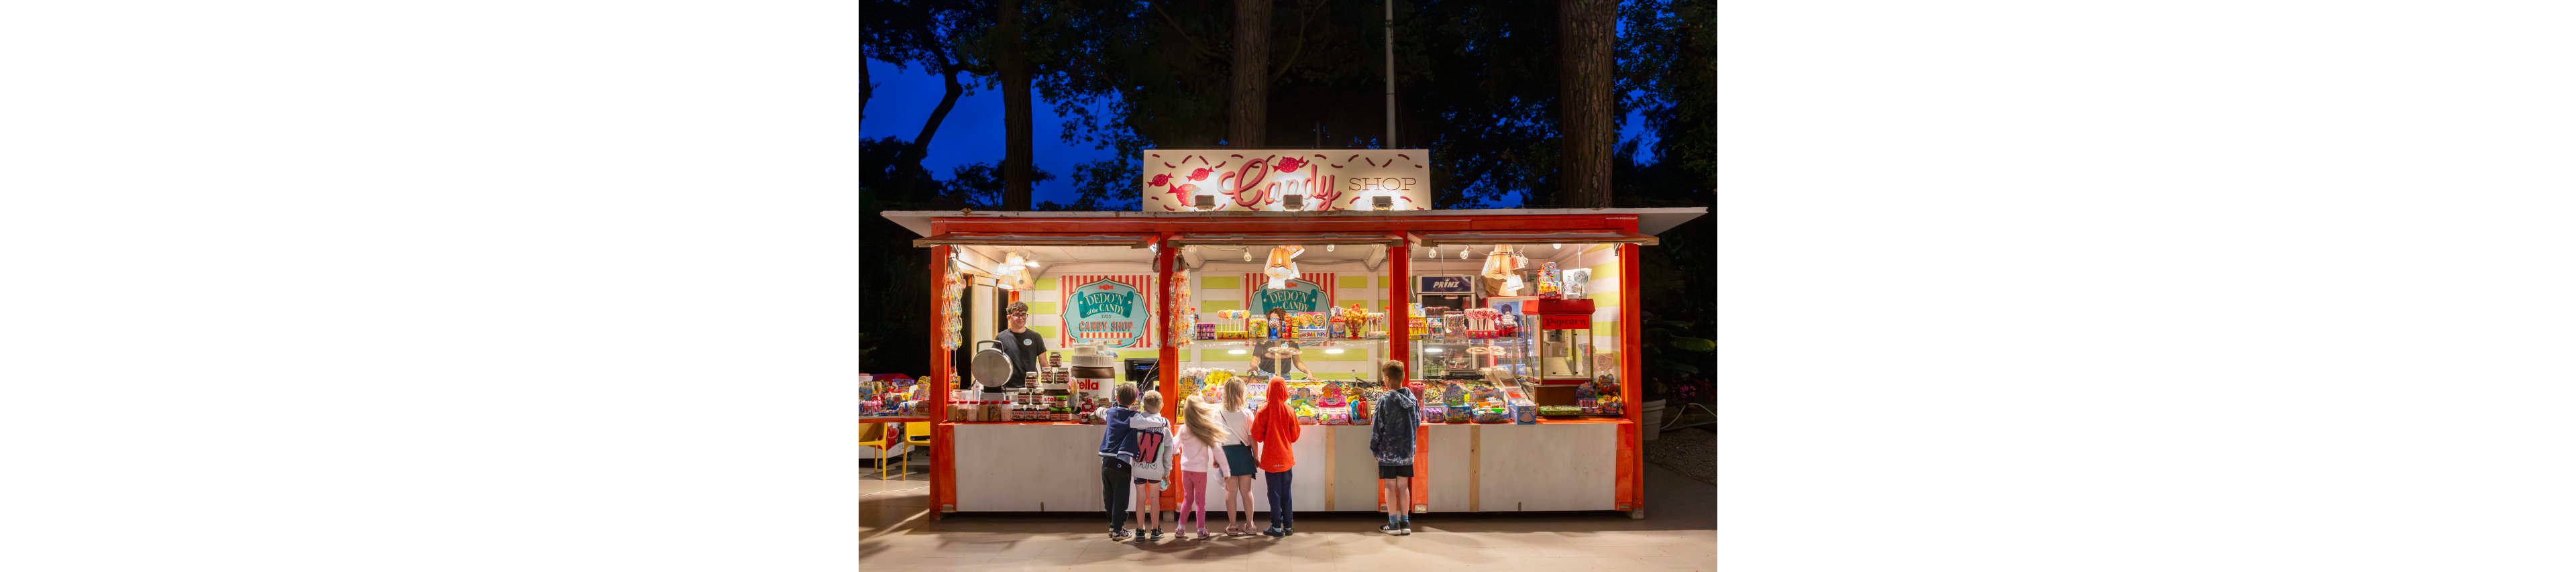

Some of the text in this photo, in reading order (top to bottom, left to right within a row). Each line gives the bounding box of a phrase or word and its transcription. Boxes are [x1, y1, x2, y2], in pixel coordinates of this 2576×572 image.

[1217, 158, 1417, 211] Candy SHOP
[1085, 293, 1126, 306] DEDO'N
[1269, 291, 1309, 304] DEDO'N
[1099, 303, 1126, 314] CANDY
[1283, 300, 1310, 312] CANDY
[1079, 321, 1134, 332] CANDY SHOP
[1545, 317, 1587, 327] Popcorn
[1136, 429, 1164, 463] W
